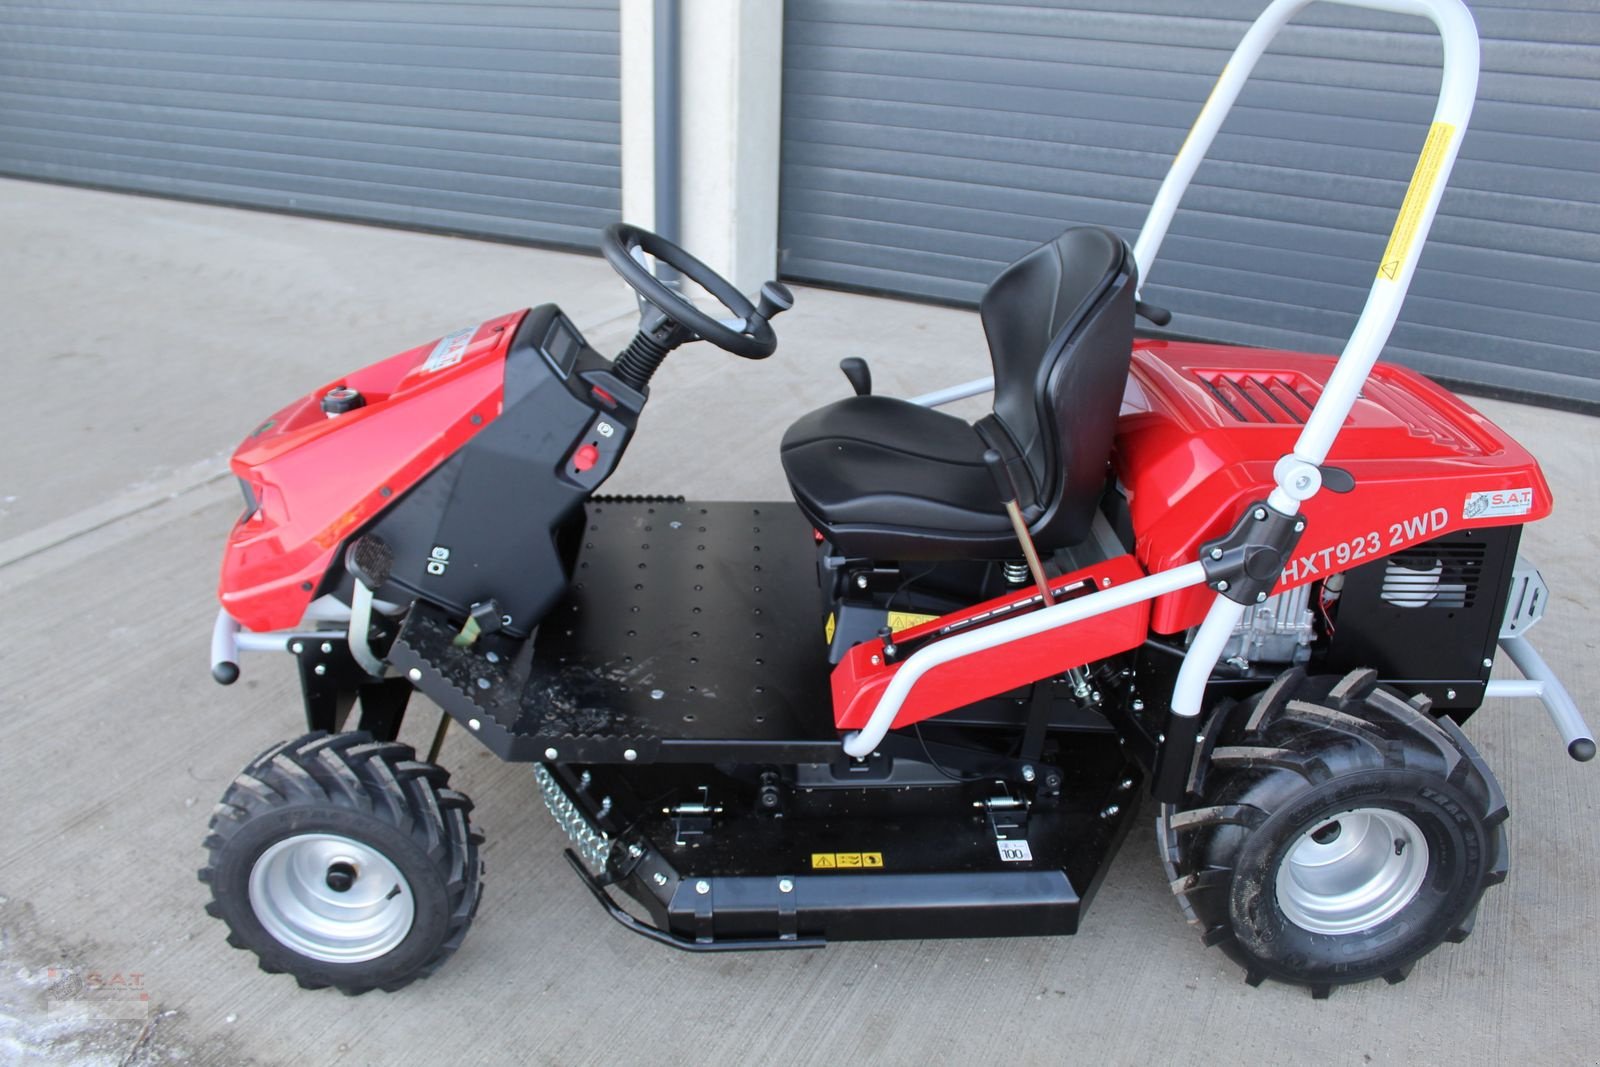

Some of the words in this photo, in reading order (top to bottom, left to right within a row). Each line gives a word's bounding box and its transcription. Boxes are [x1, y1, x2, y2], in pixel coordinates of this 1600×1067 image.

[1280, 532, 1382, 586] HXT923
[1388, 507, 1449, 547] 2WD
[1002, 849, 1023, 859] 100
